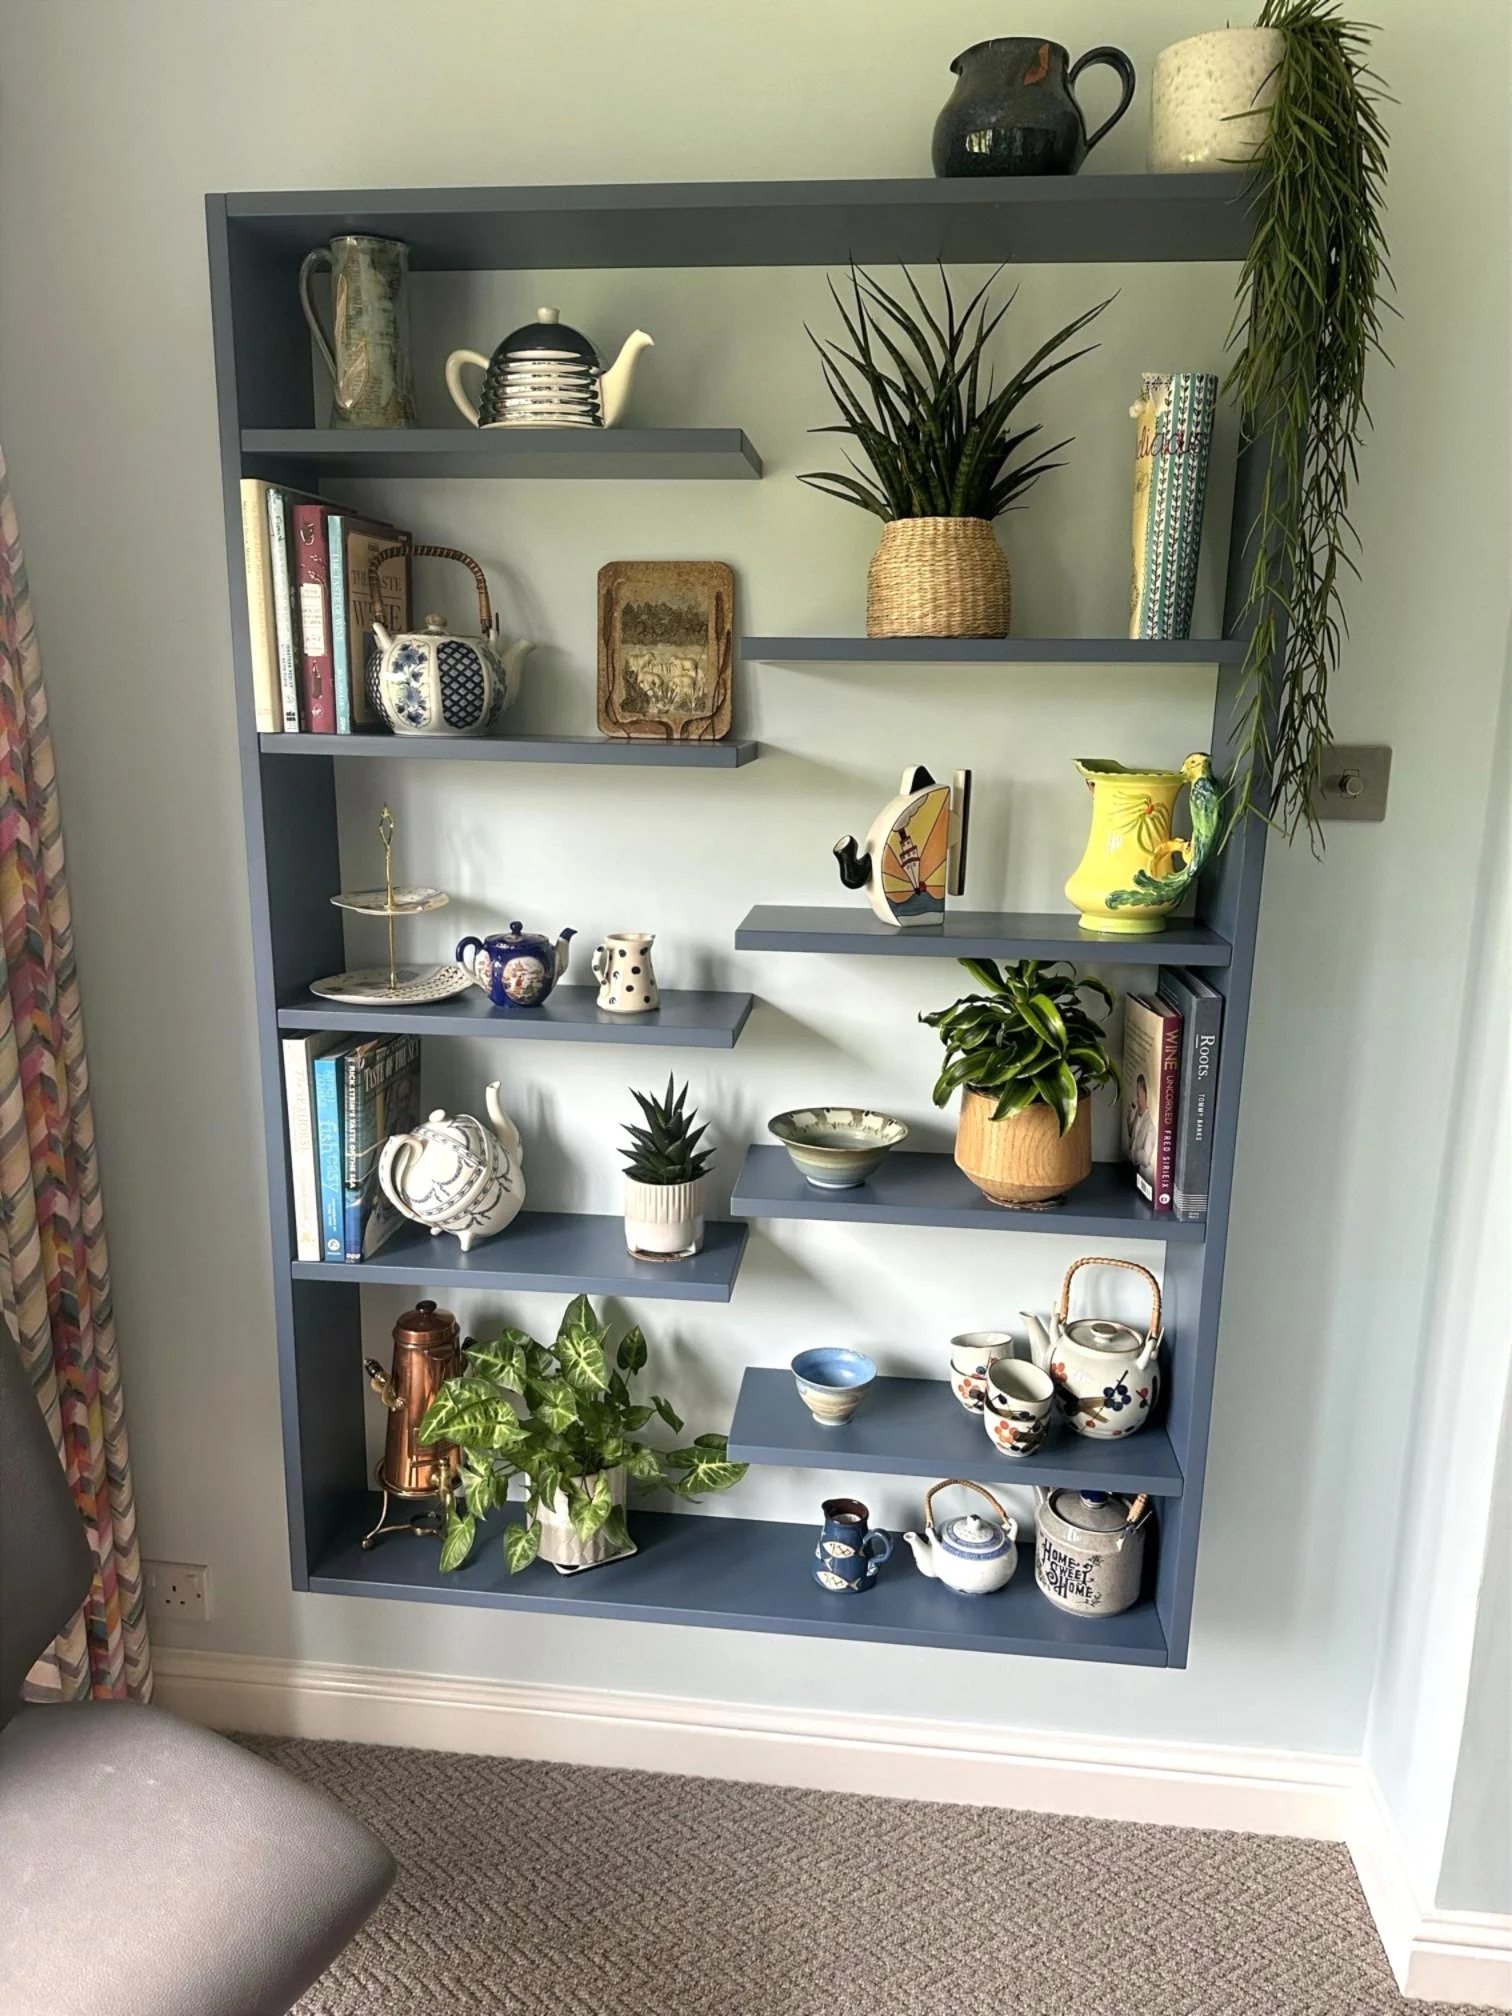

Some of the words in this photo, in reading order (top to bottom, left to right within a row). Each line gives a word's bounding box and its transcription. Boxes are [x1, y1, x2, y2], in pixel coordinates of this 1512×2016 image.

[380, 575, 402, 592] STE
[353, 600, 402, 631] WE
[1164, 1029, 1179, 1071] WINE
[1198, 1035, 1215, 1080] Roots.
[364, 1061, 385, 1092] TASTE
[1164, 1075, 1174, 1125] UNCORKED
[1196, 1094, 1205, 1117] TOMMY
[1163, 1130, 1171, 1152] FRED
[1195, 1119, 1204, 1141] BANKS
[1161, 1156, 1171, 1188] SIRIEIX
